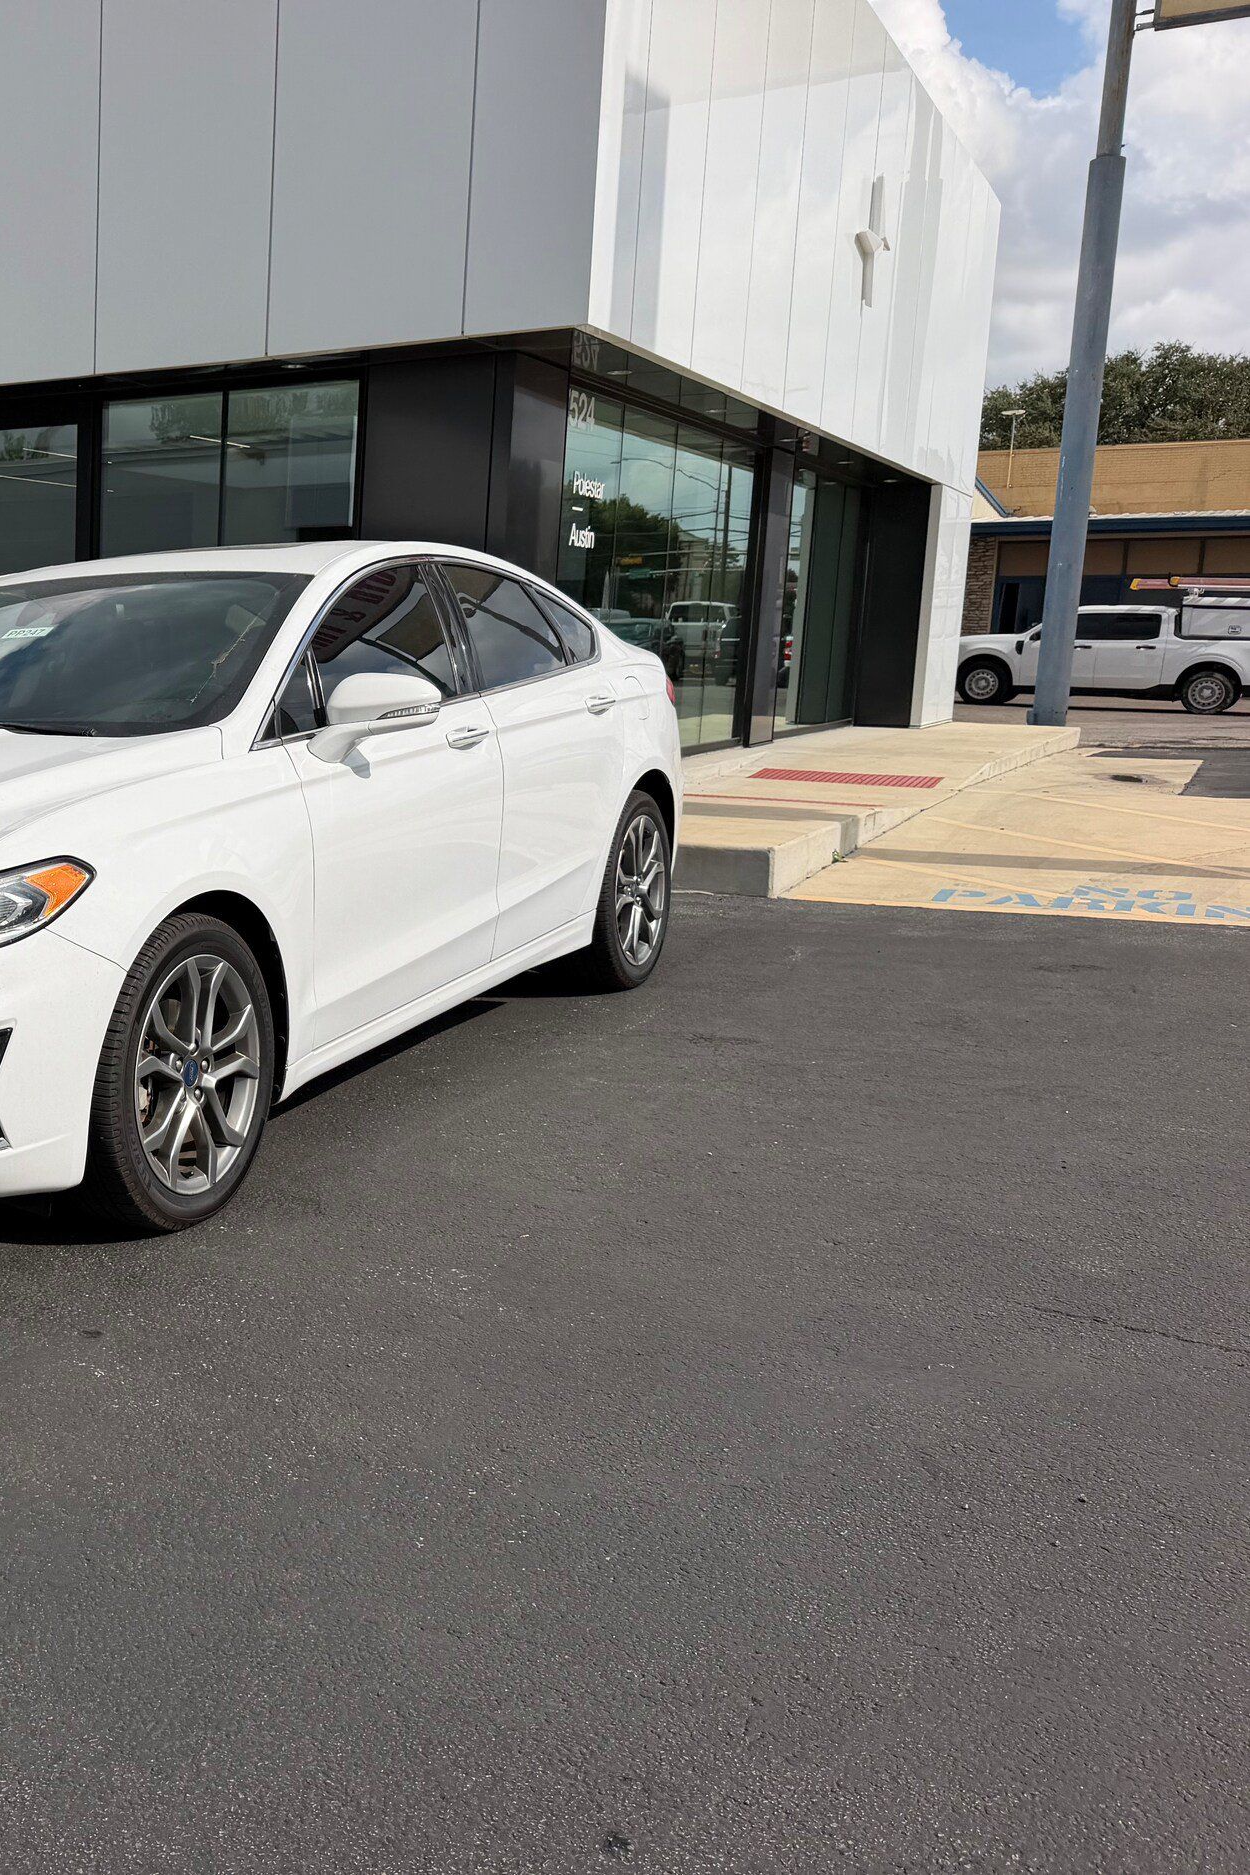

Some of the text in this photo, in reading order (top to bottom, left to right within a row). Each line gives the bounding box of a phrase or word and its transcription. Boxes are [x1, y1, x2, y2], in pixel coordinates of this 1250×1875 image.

[568, 388, 595, 432] 524
[573, 471, 605, 499] Polestar
[568, 522, 595, 549] Austin
[1072, 885, 1193, 901] NO
